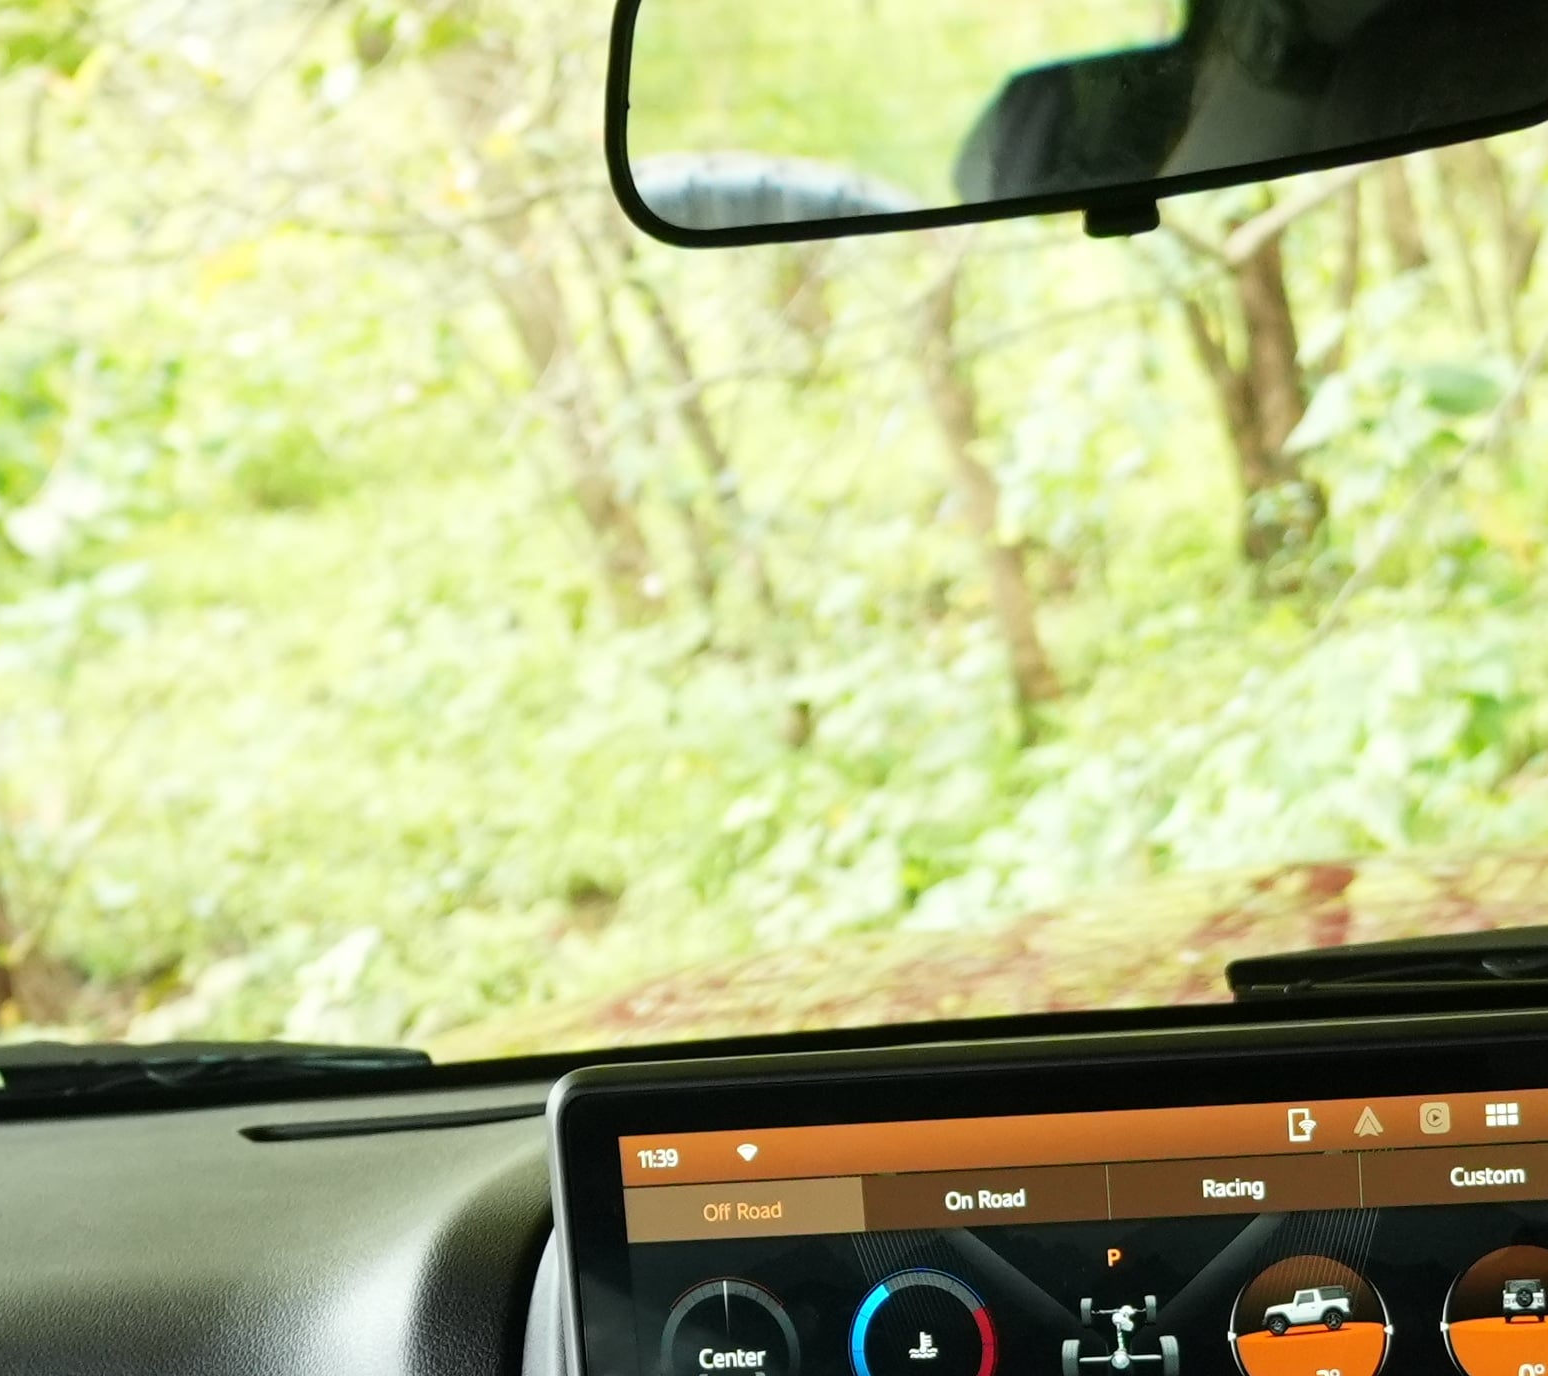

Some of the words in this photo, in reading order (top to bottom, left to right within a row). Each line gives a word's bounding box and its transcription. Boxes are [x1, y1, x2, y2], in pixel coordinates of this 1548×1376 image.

[637, 1148, 679, 1169] 11:39
[1450, 1166, 1525, 1187] Custom
[1202, 1177, 1265, 1201] Racing
[944, 1191, 974, 1211] On
[977, 1189, 1026, 1210] Road
[702, 1203, 733, 1222] Off
[736, 1202, 783, 1220] Road
[1107, 1248, 1121, 1266] P
[698, 1348, 766, 1370] Center
